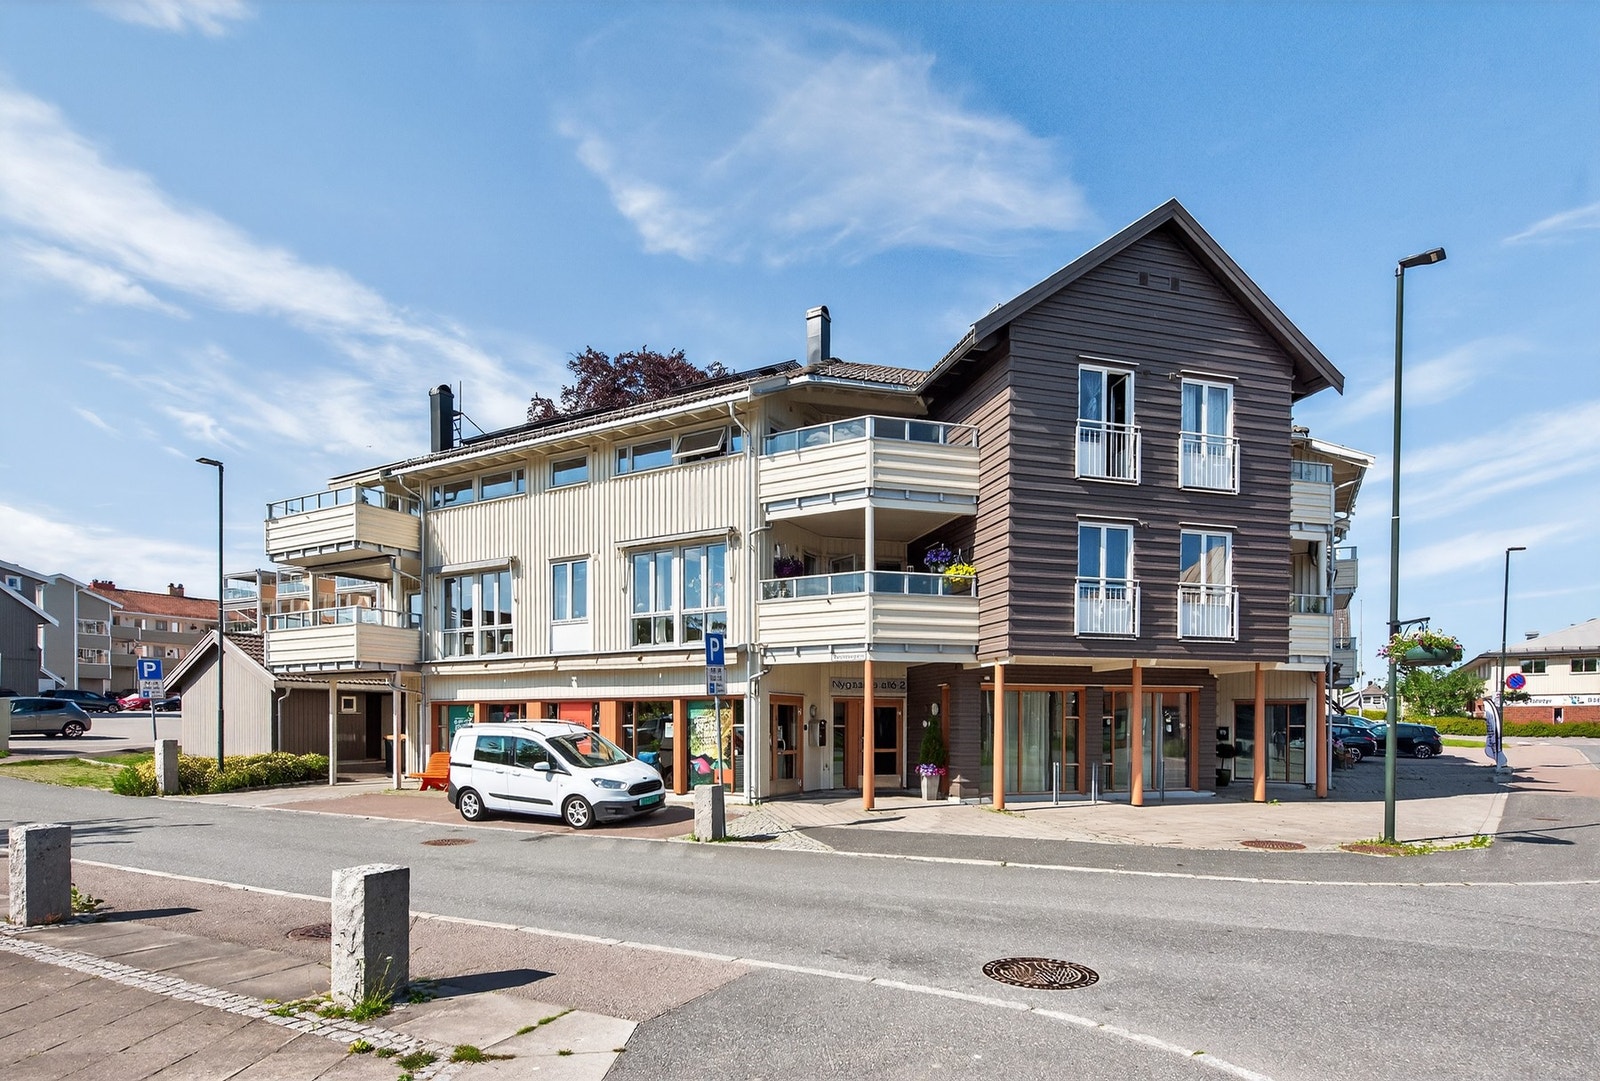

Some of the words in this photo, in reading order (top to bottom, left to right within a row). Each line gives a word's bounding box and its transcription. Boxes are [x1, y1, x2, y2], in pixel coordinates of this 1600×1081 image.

[709, 637, 720, 662] P
[143, 661, 157, 678] P
[899, 680, 906, 690] 2
